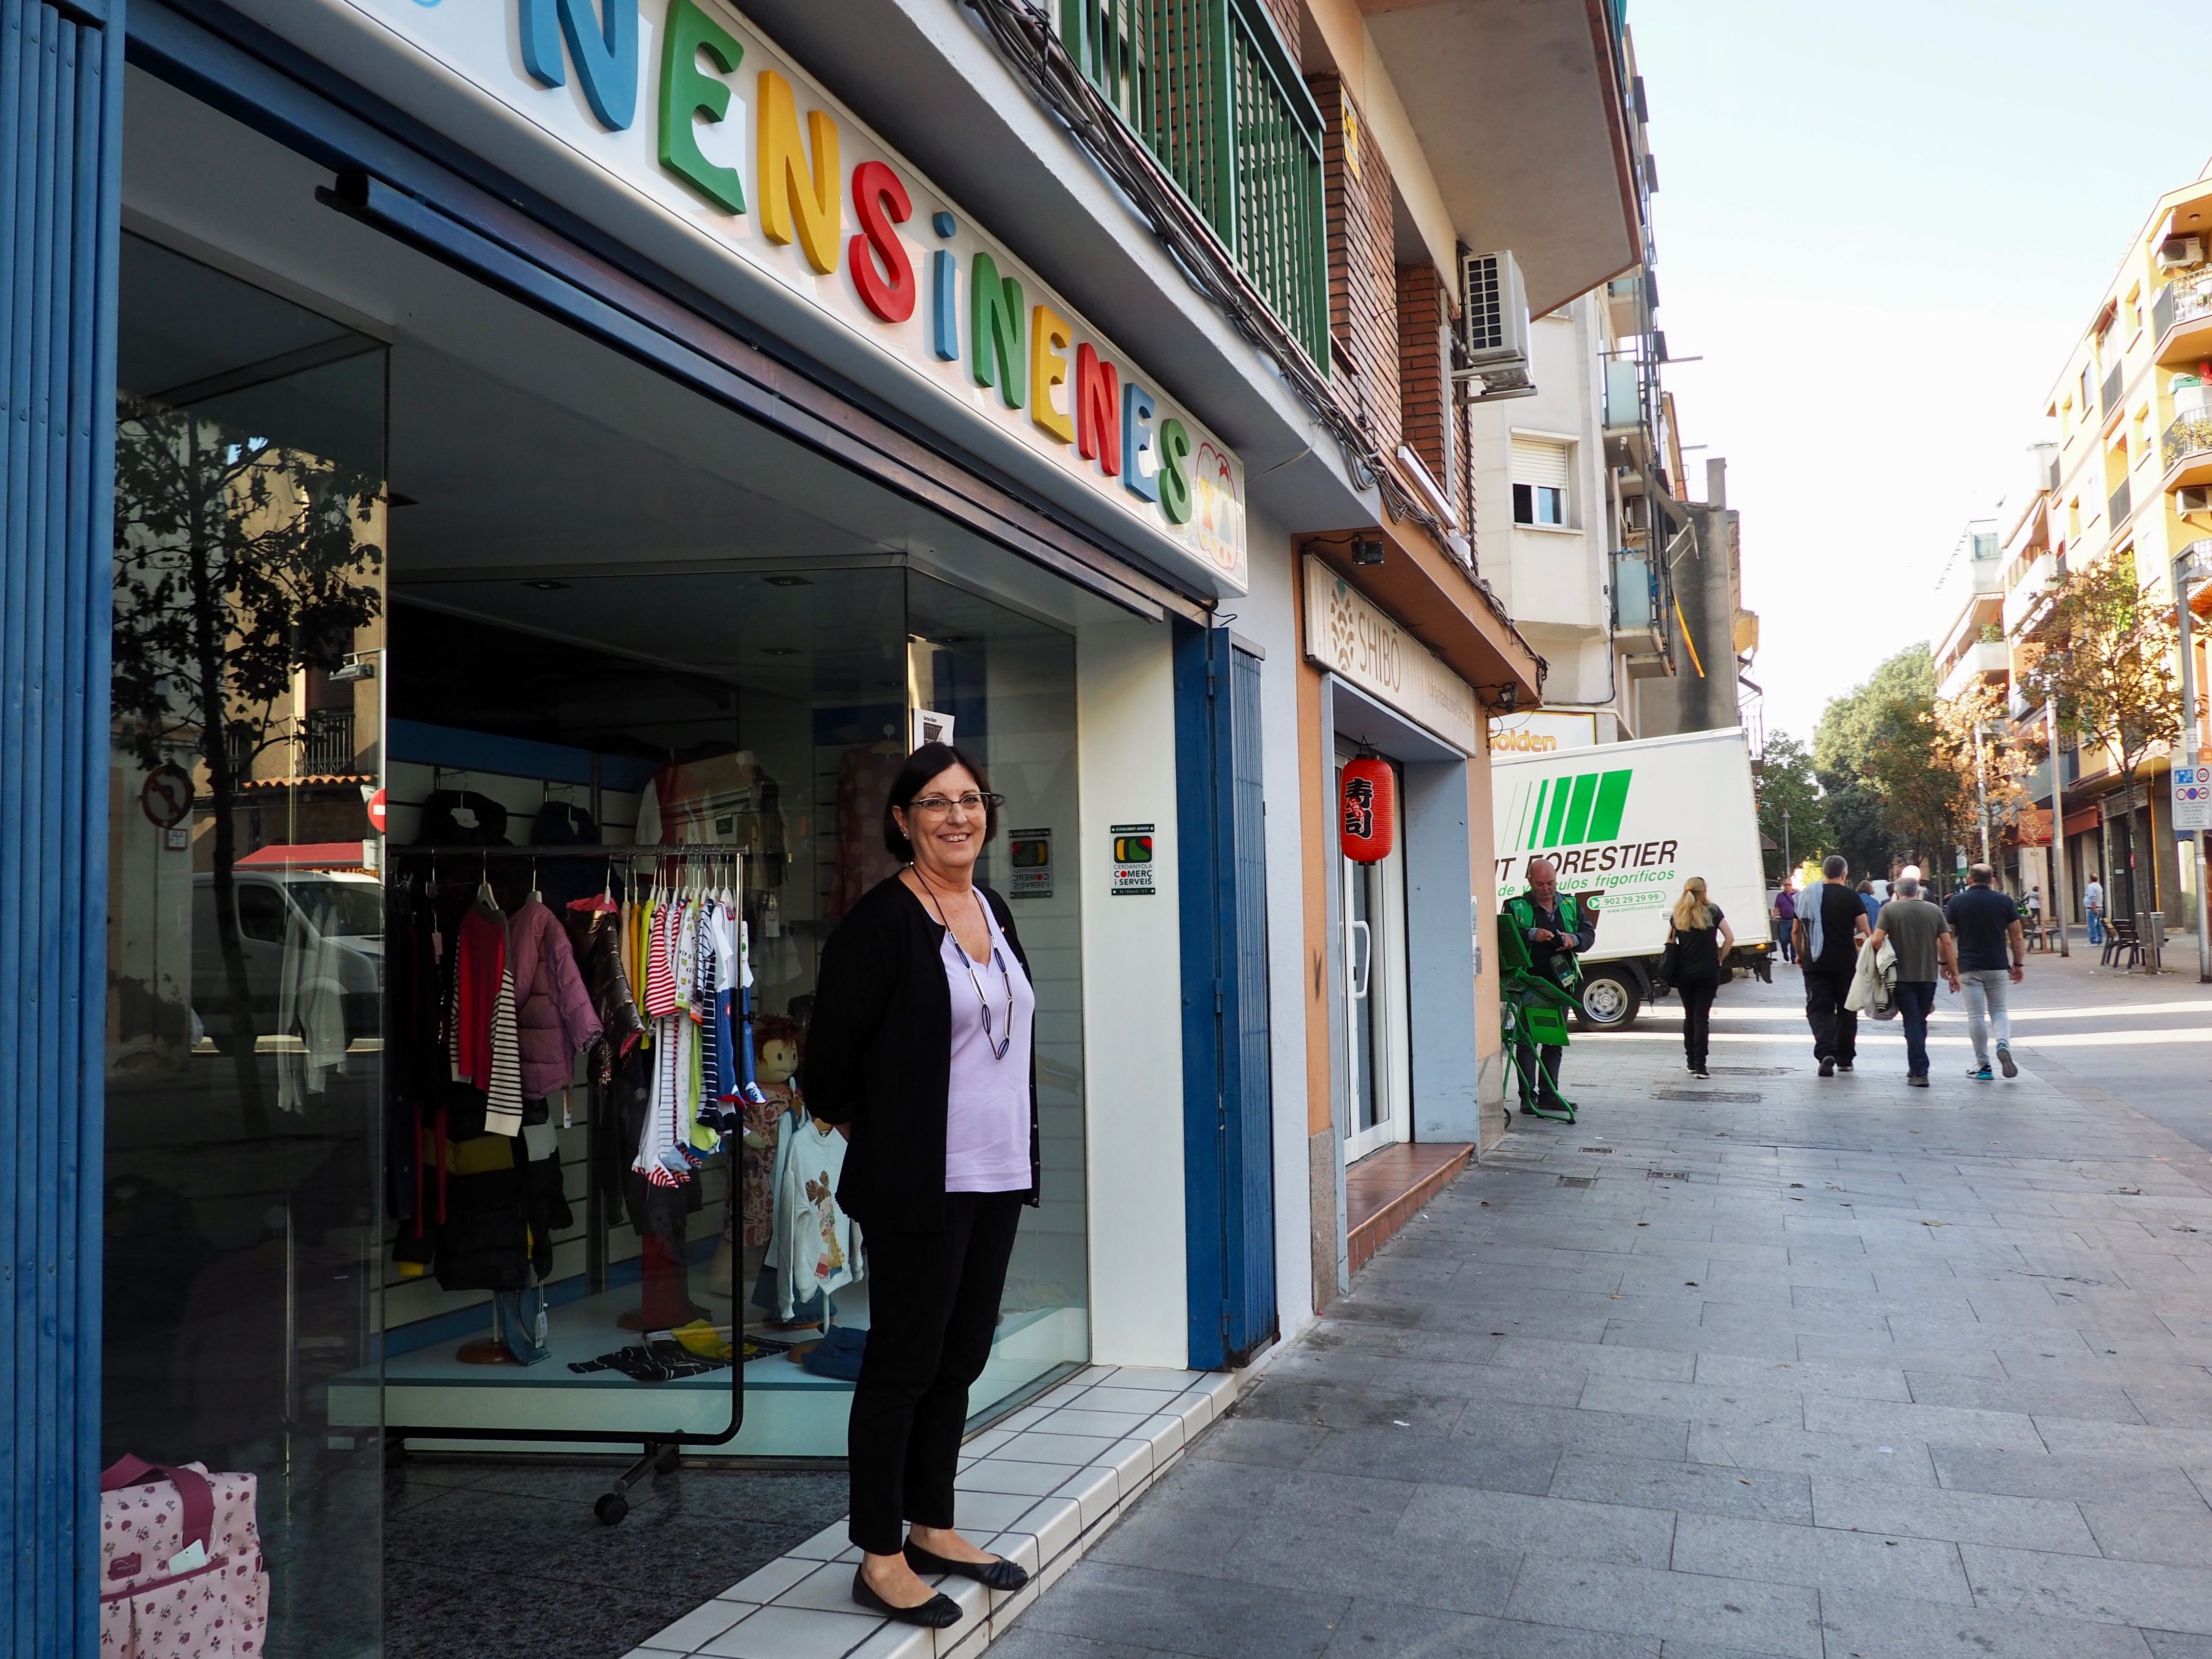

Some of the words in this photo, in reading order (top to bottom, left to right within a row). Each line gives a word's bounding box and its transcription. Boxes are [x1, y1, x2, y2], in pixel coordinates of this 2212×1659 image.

[1345, 777, 1374, 839] 寿司
[1525, 840, 1678, 879] FORESTIER
[1498, 884, 1515, 897] de
[1595, 869, 1675, 888] frigoríficos
[1604, 897, 1620, 905] 902
